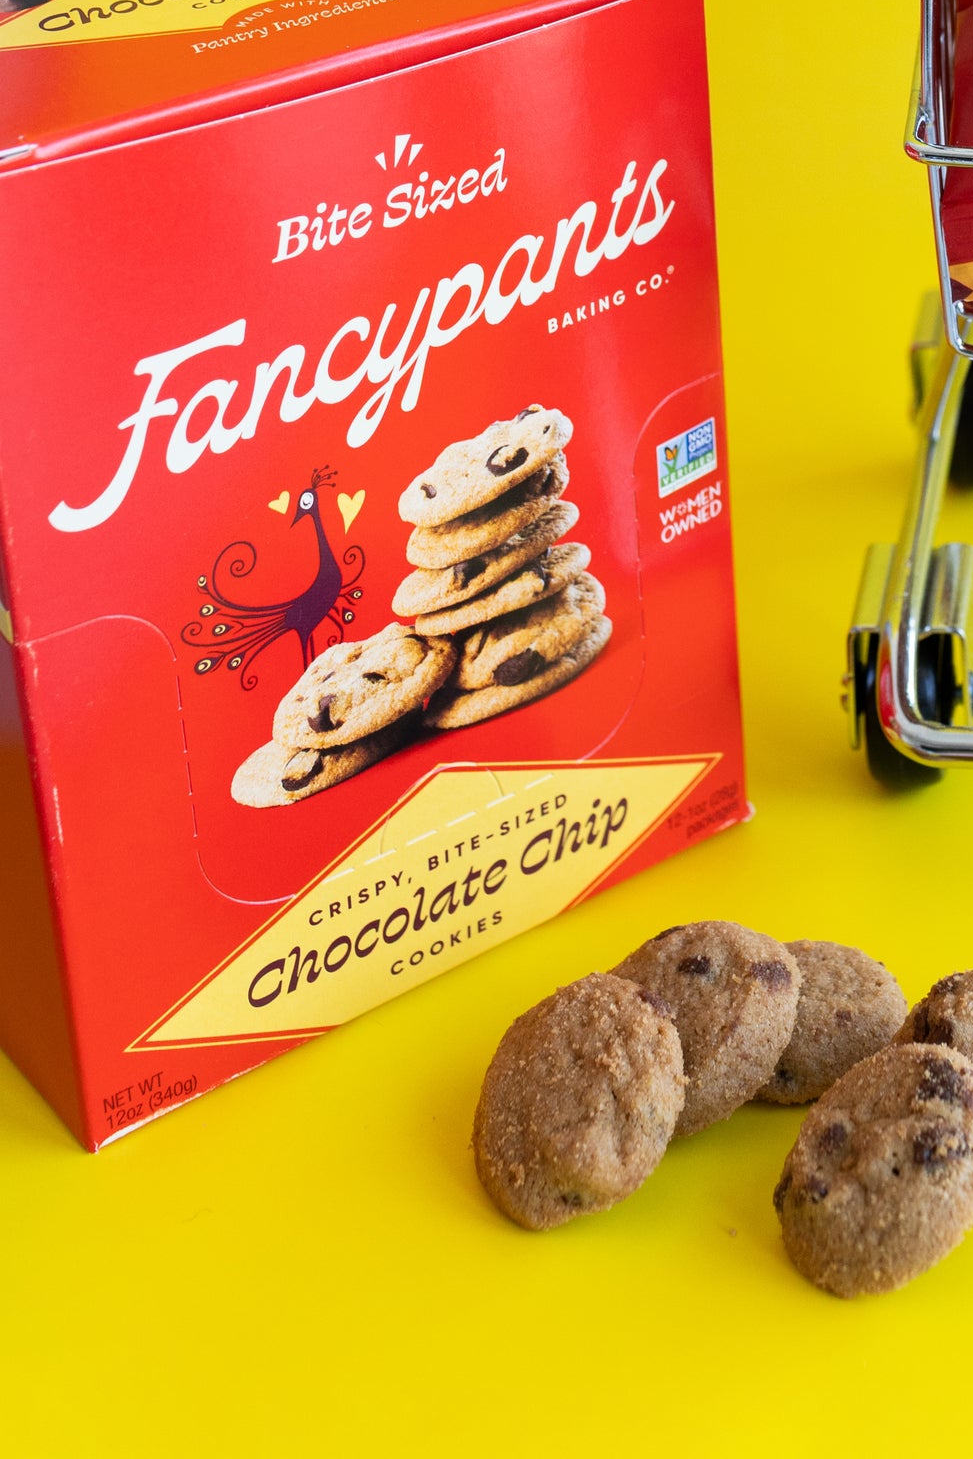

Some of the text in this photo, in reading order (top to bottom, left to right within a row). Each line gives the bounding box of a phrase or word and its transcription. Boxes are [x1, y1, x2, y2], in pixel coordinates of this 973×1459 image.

[191, 25, 269, 54] Pantry
[235, 7, 273, 29] MADE
[272, 148, 508, 263] Bite Sized
[547, 290, 626, 334] BAKING
[48, 159, 676, 533] Fancypants
[660, 499, 722, 543] OWNED
[308, 792, 568, 928] CRISPY, BITE-SIZED
[248, 795, 628, 1008] Chocolate Chip
[390, 910, 503, 976] COOKIES
[103, 1071, 163, 1113] NET WT
[107, 1074, 198, 1129] 12oz (340g)
